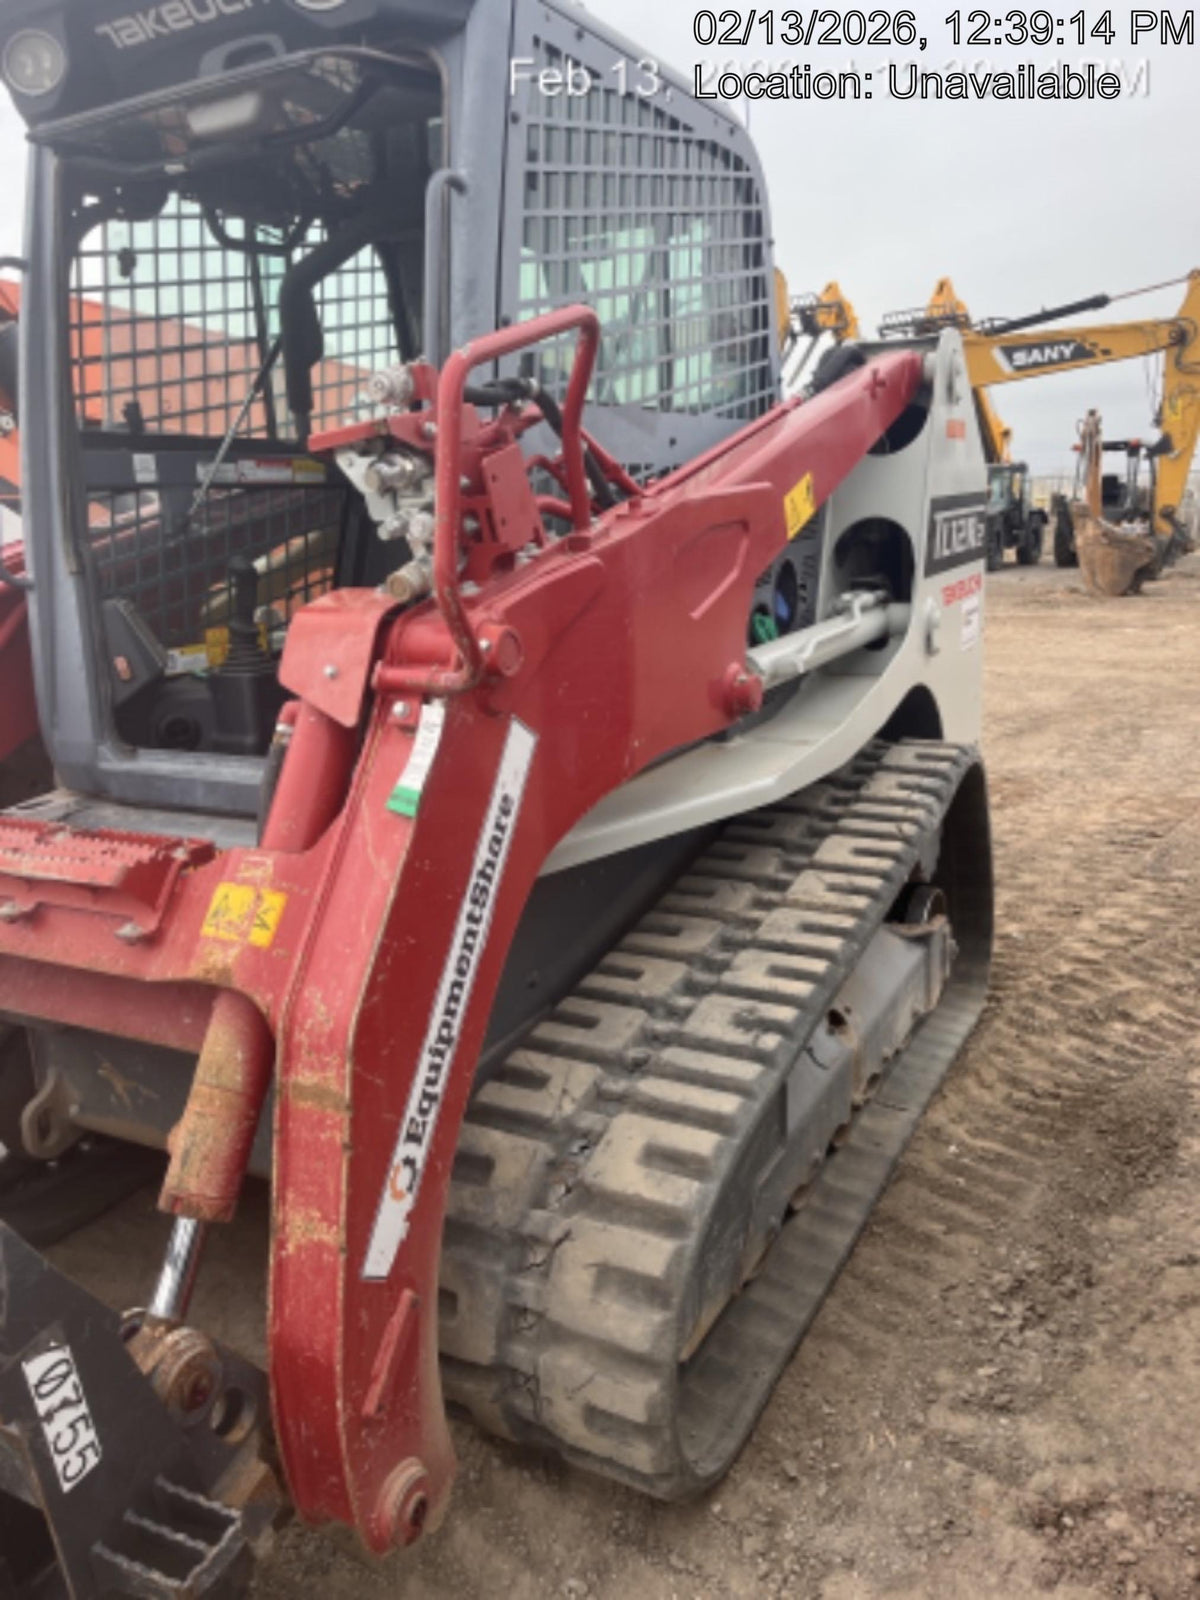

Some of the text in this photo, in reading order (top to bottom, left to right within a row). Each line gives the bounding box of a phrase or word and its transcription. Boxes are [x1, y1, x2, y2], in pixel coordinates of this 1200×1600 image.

[1011, 341, 1077, 366] SANY
[403, 792, 515, 1147] EquipmentShare
[34, 1357, 101, 1483] 0755
